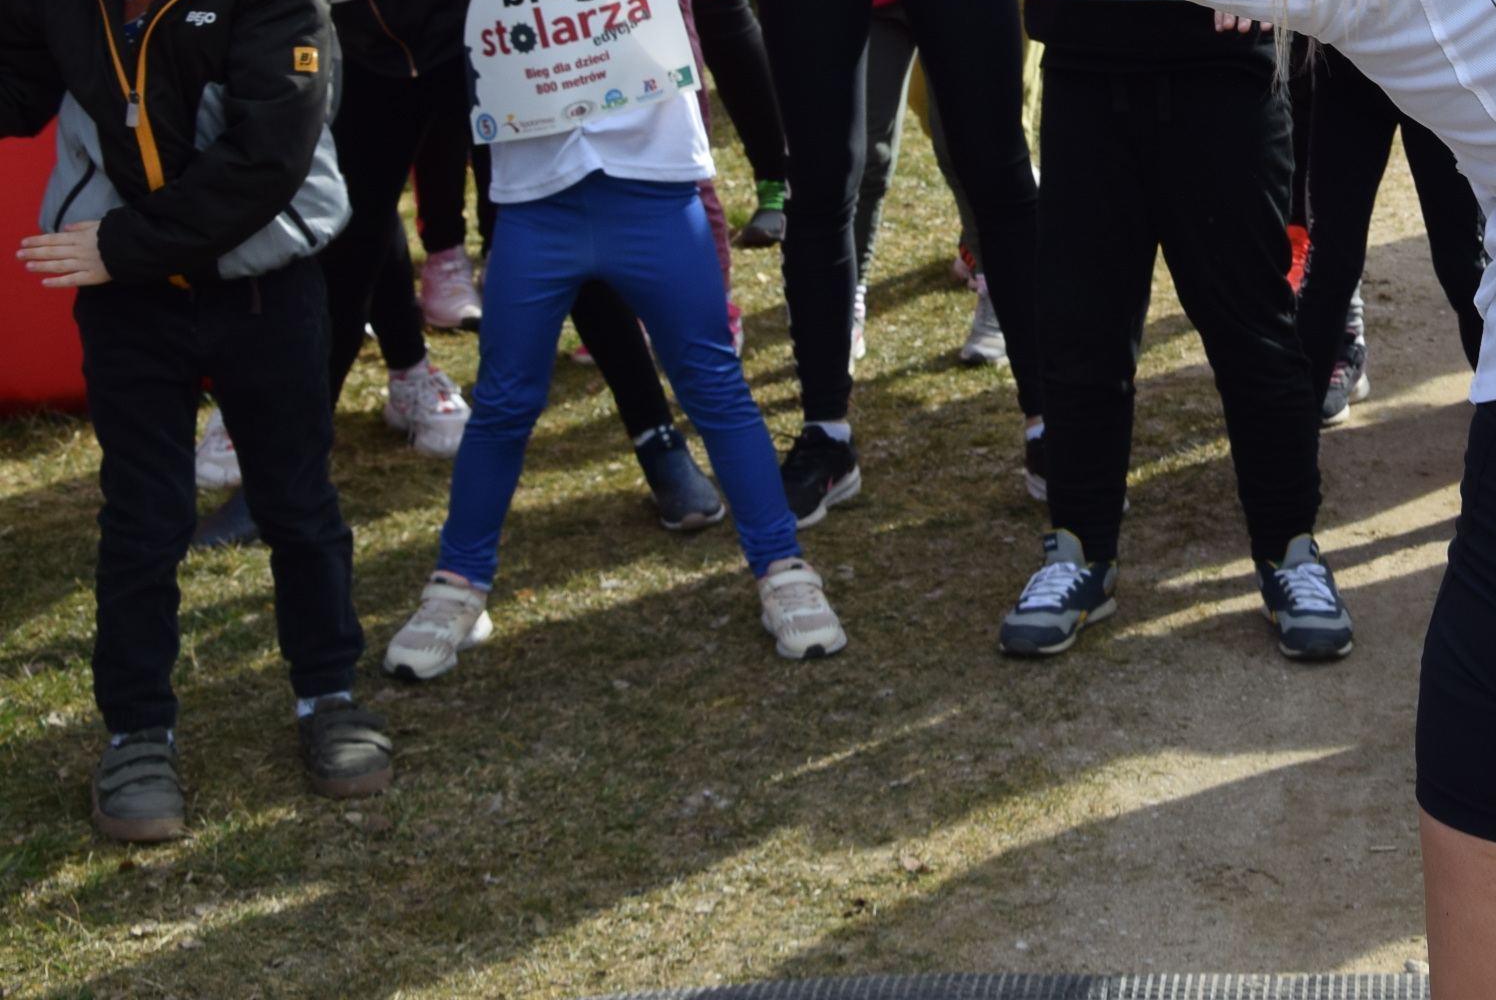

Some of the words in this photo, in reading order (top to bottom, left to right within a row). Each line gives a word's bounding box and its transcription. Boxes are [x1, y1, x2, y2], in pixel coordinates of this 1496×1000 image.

[593, 18, 638, 47] edycja
[525, 66, 550, 80] Bieg
[552, 61, 572, 75] dla
[575, 50, 611, 68] dzieci
[535, 81, 558, 95] 800
[562, 70, 607, 90] metrów
[482, 118, 492, 135] 5
